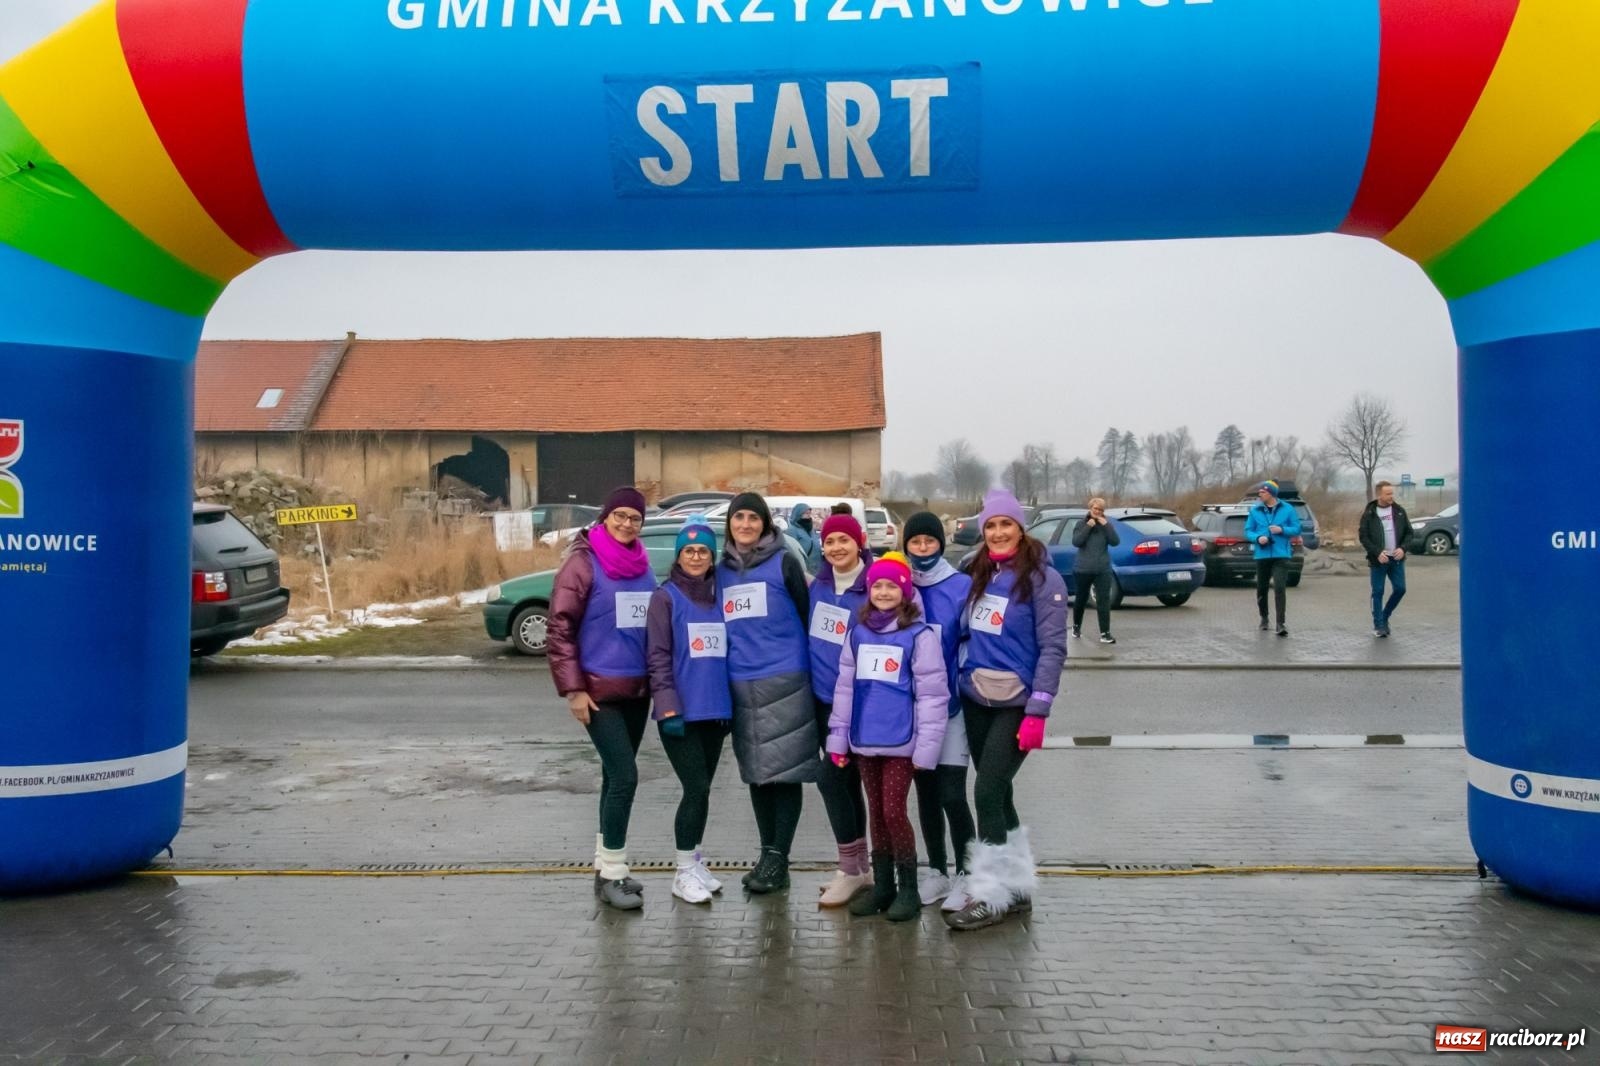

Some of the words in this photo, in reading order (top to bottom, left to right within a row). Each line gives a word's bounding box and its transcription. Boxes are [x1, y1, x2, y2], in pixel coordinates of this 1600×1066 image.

[387, 0, 623, 29] GMINA
[637, 78, 948, 187] START
[277, 507, 339, 523] PARKING
[0, 561, 47, 574] amiętaj
[631, 604, 647, 618] 29
[735, 597, 752, 611] 64
[975, 606, 992, 621] 27
[820, 617, 835, 633] 33
[704, 635, 719, 649] 32
[871, 658, 879, 671] 1
